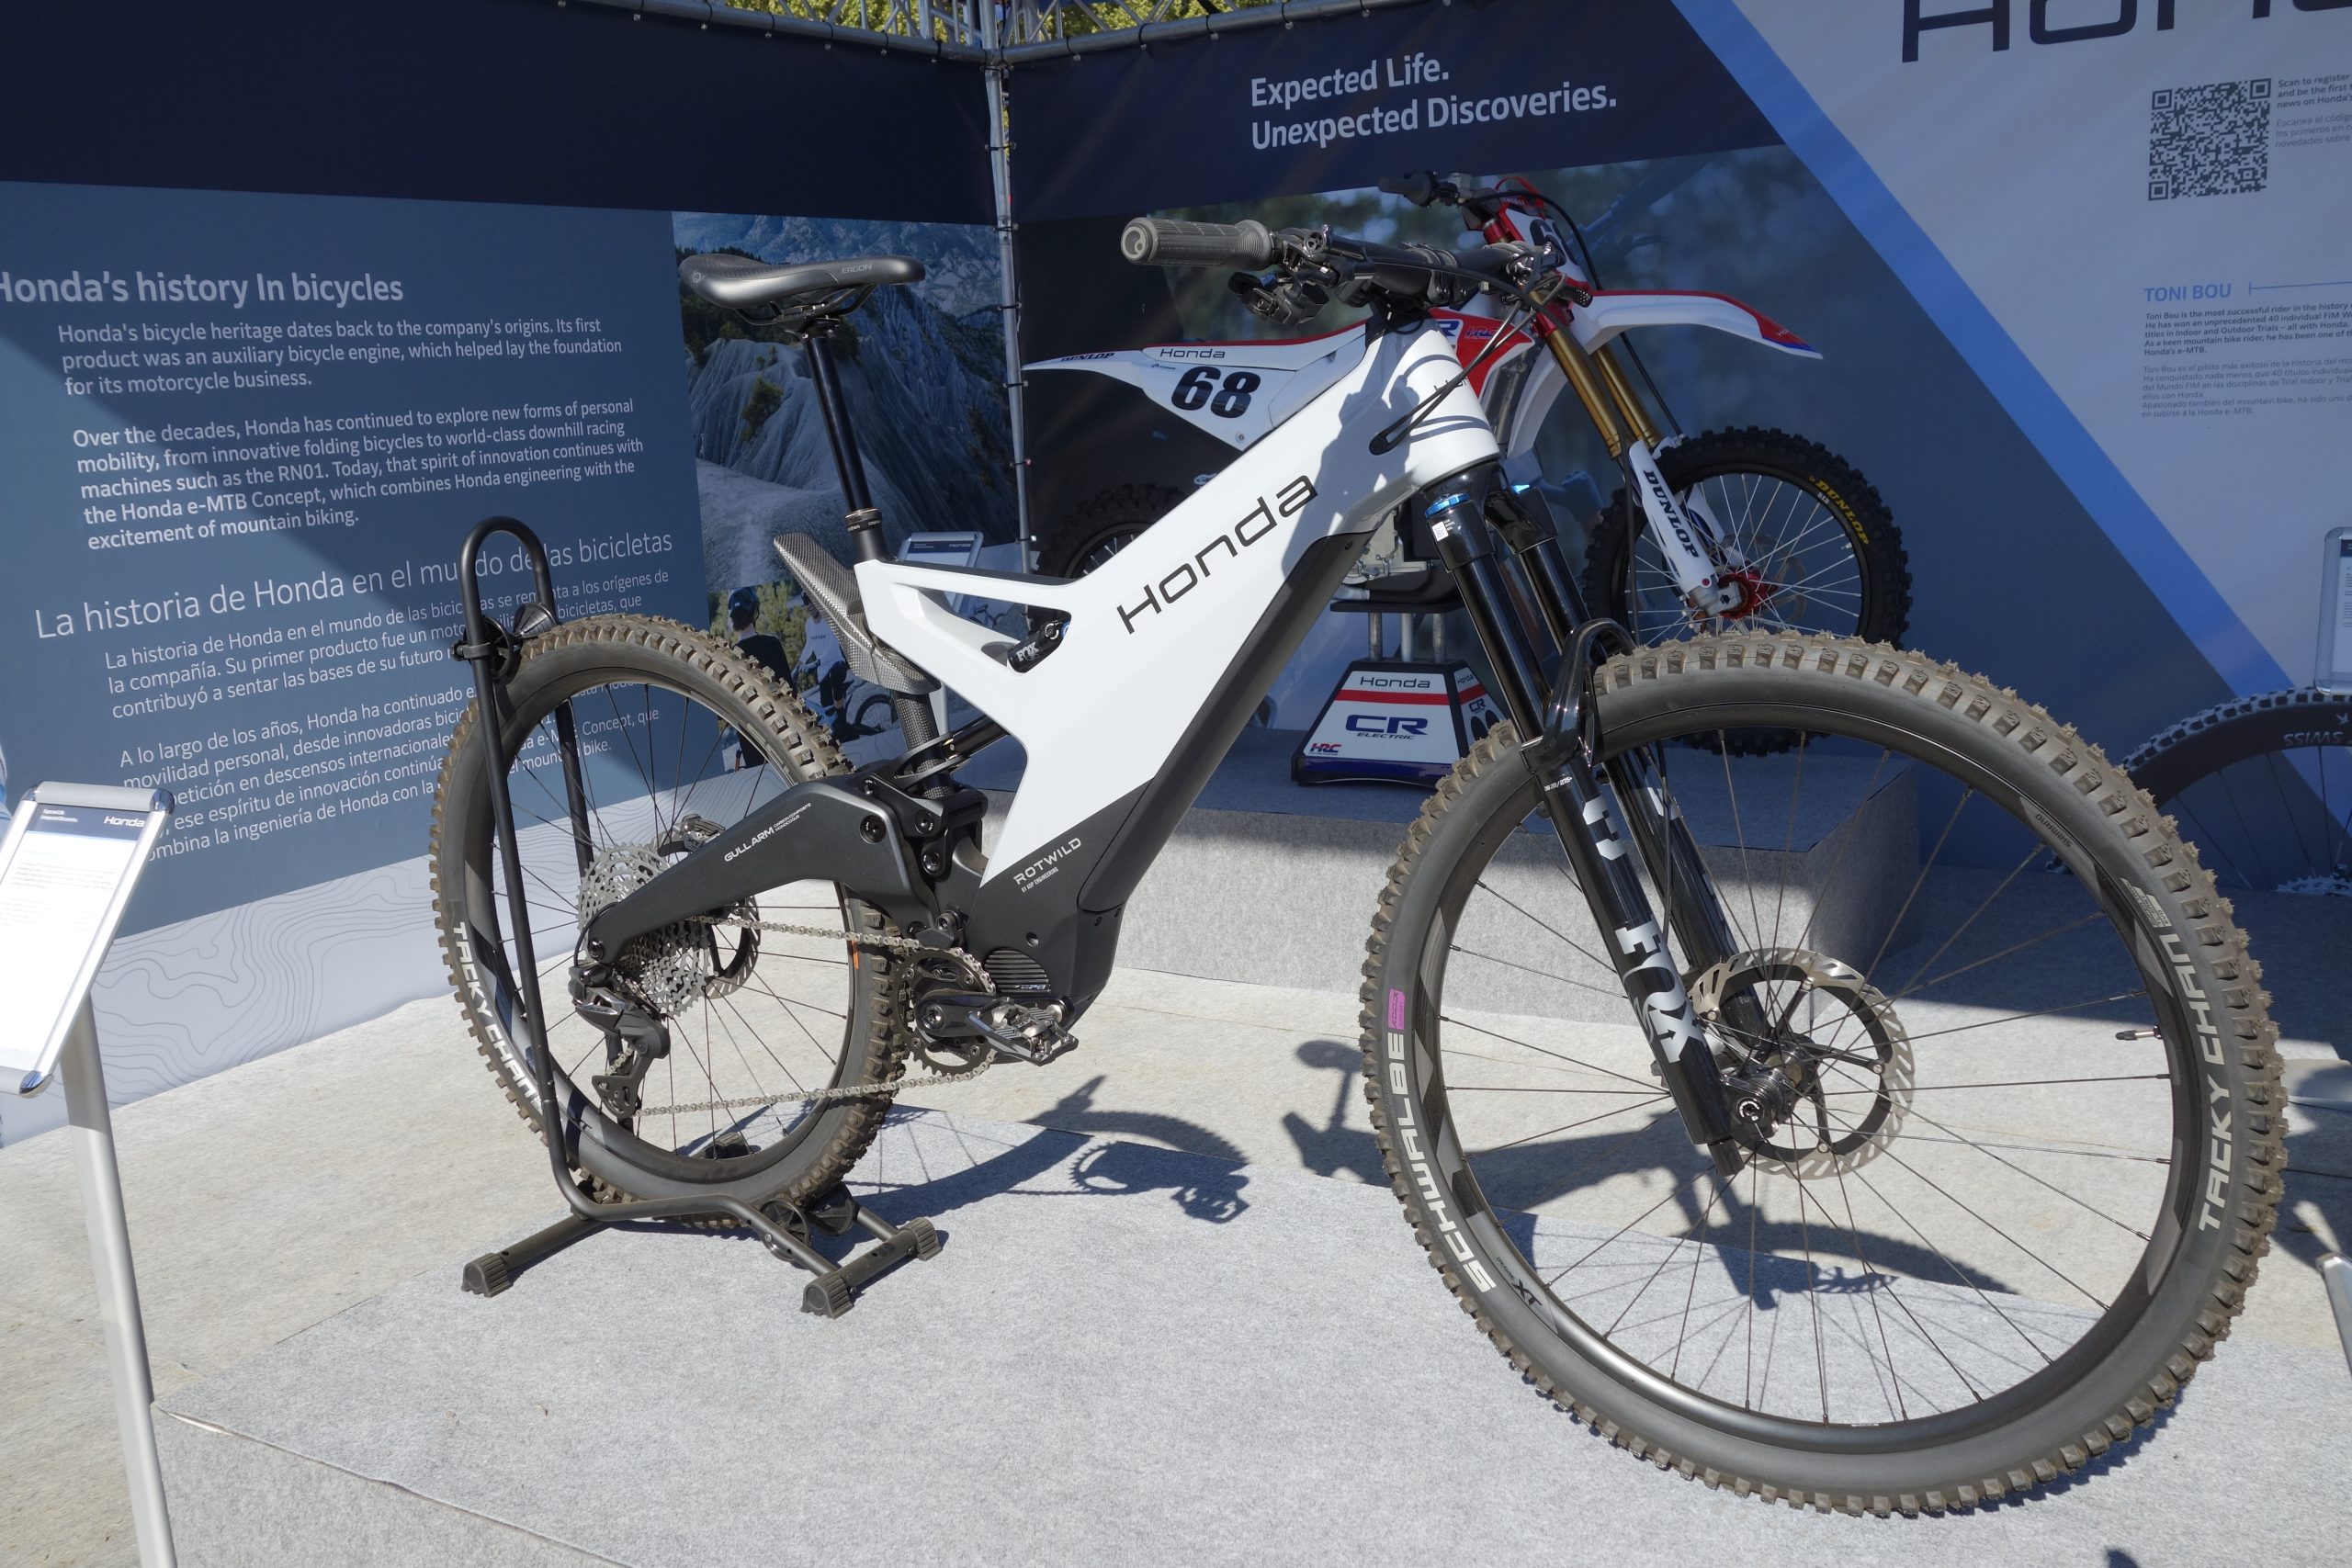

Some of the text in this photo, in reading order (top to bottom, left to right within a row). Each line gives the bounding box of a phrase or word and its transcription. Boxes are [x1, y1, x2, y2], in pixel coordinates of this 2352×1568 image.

[1251, 52, 1449, 109] Expected Life.
[1252, 82, 1617, 149] Unexpected Discoveries.
[841, 263, 872, 275] ERGON
[136, 271, 248, 309] history
[256, 272, 285, 301] In
[291, 271, 403, 308] bicycles
[2144, 284, 2231, 301] TONI BOU
[57, 316, 601, 345] Honda's bicycle heritage dates back to the company's origins. Its first
[62, 337, 622, 372] product was an auxiliary bicycle engine, which helped lay the foundation
[1060, 352, 1115, 362] DUNLOP
[1159, 347, 1226, 358] Honda
[63, 369, 311, 394] for its motorcycle business.
[1171, 366, 1261, 419] 68
[72, 397, 633, 446] Over the decades, Honda has continued to explore new forms of personal
[82, 457, 635, 524] the Honda e-MTB Concept, which combines Honda engineering with the
[87, 508, 358, 549] excitement of mountain biking.
[1643, 470, 1699, 558] DUNLOP
[1815, 479, 1869, 544] DUNLOP
[1116, 474, 1318, 635] Honda
[35, 608, 74, 637] La
[83, 591, 200, 630] historia
[209, 582, 245, 614] de
[254, 570, 345, 608] Honda
[352, 571, 383, 593] en
[390, 559, 412, 588] el
[420, 551, 503, 587] mudo
[578, 531, 672, 562] bicicletas
[104, 605, 427, 668] La historia de Honda en el mundo de las
[1016, 641, 1039, 661] FOX
[1360, 676, 1430, 688] Honda
[119, 685, 462, 767] A lo largo de los años, Honda ha continuado
[1346, 714, 1428, 735] CR
[1357, 732, 1414, 740] ELECTRIC
[104, 816, 145, 828] Honda
[2035, 813, 2073, 848] SHIMANO
[1013, 837, 1081, 886] ROTWILD
[453, 922, 540, 1098] TACKY CHAN
[2159, 933, 2233, 1233] TACKY CHAN
[1388, 1032, 1497, 1293] SCHWALBE
[1511, 1279, 1543, 1306] XT
